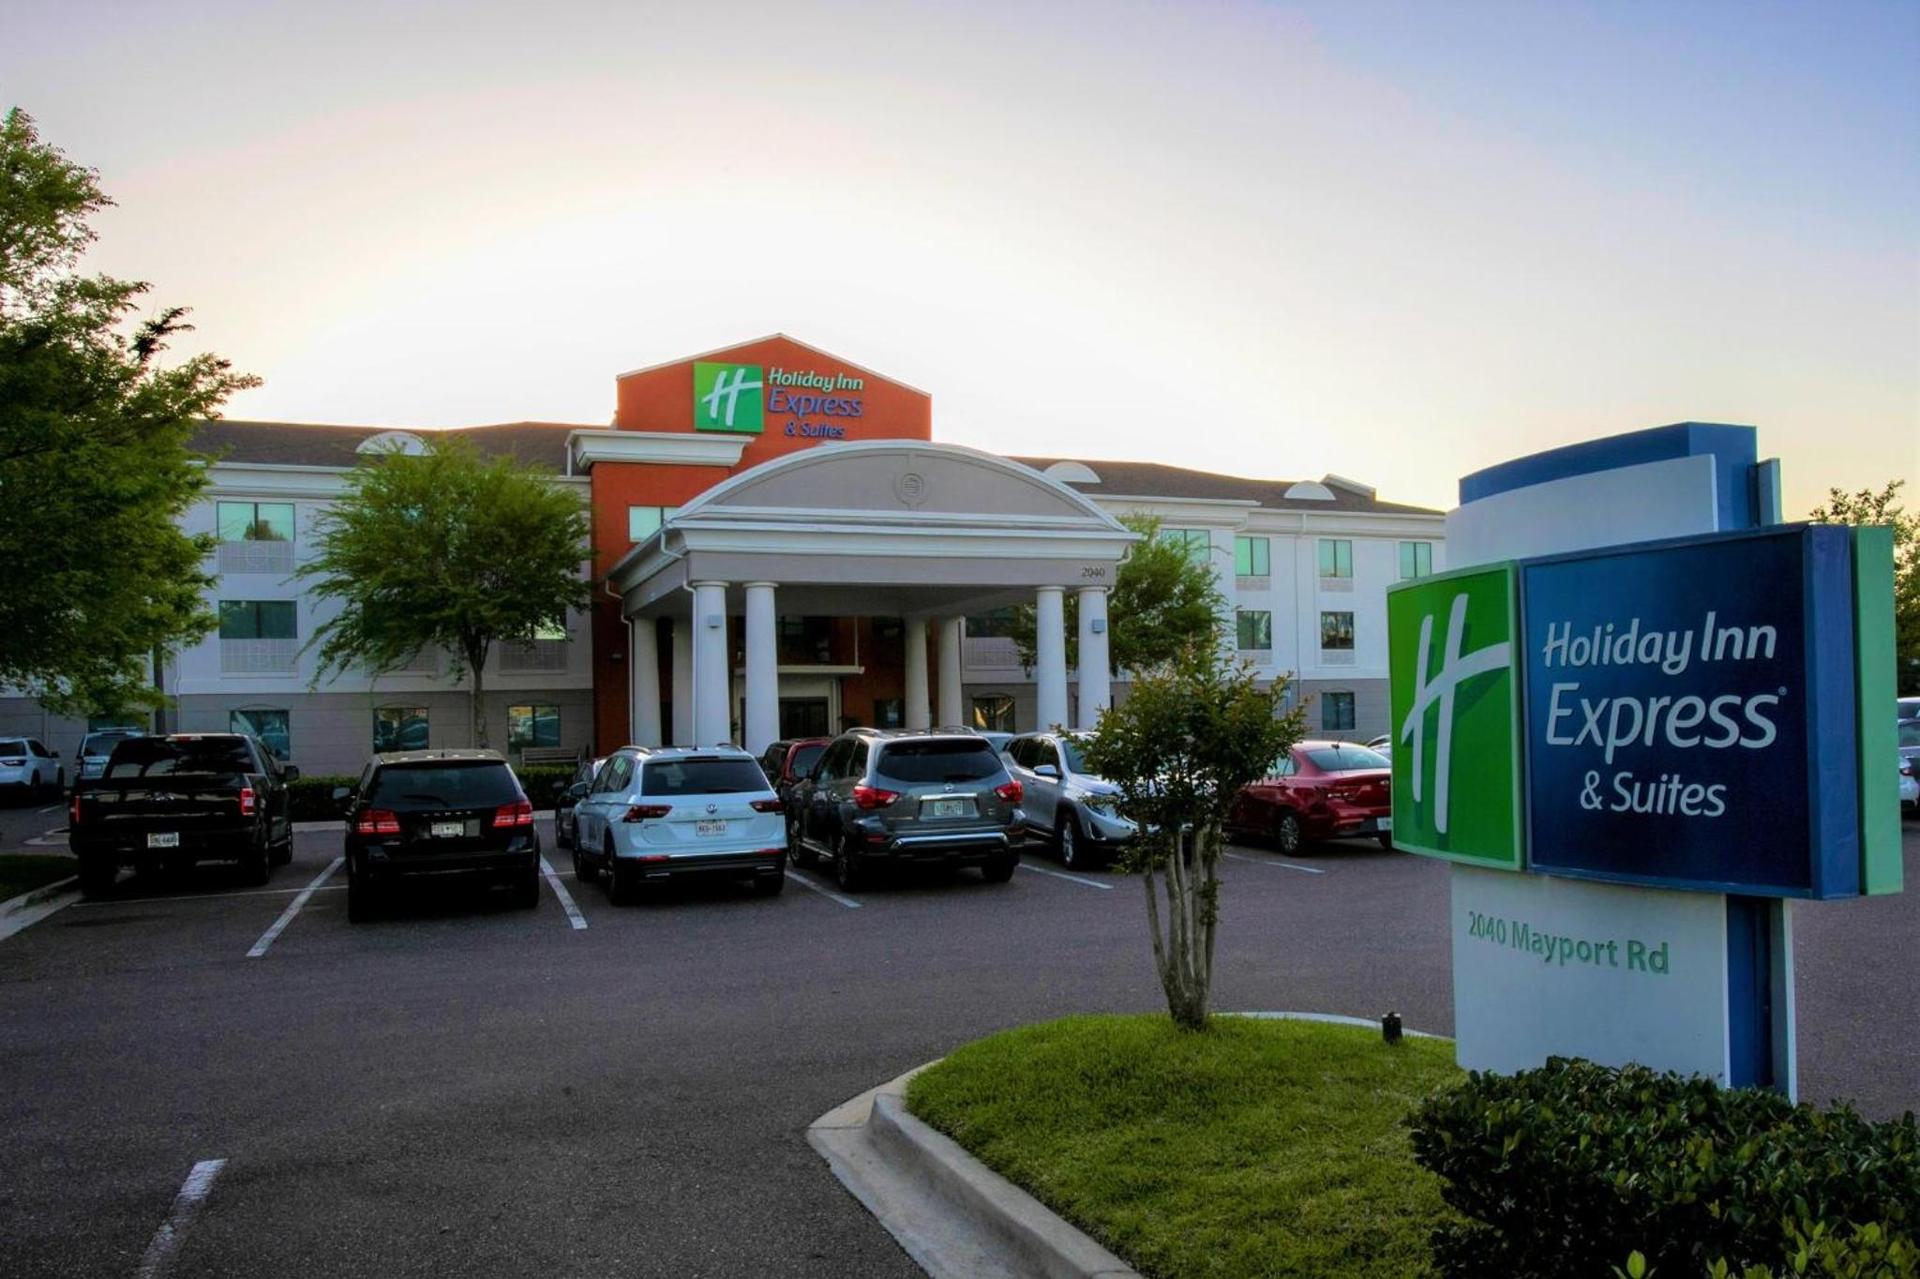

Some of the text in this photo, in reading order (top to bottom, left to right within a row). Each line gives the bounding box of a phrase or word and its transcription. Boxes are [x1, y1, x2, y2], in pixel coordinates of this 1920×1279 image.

[767, 387, 863, 418] Express
[768, 367, 864, 392] Holiday Inn
[784, 422, 846, 438] & Suites
[1542, 610, 1778, 676] Holiday Inn
[1545, 681, 1780, 764] Express
[1579, 770, 1728, 818] & Suites
[1468, 910, 1670, 974] 2040 Mayport Rd
